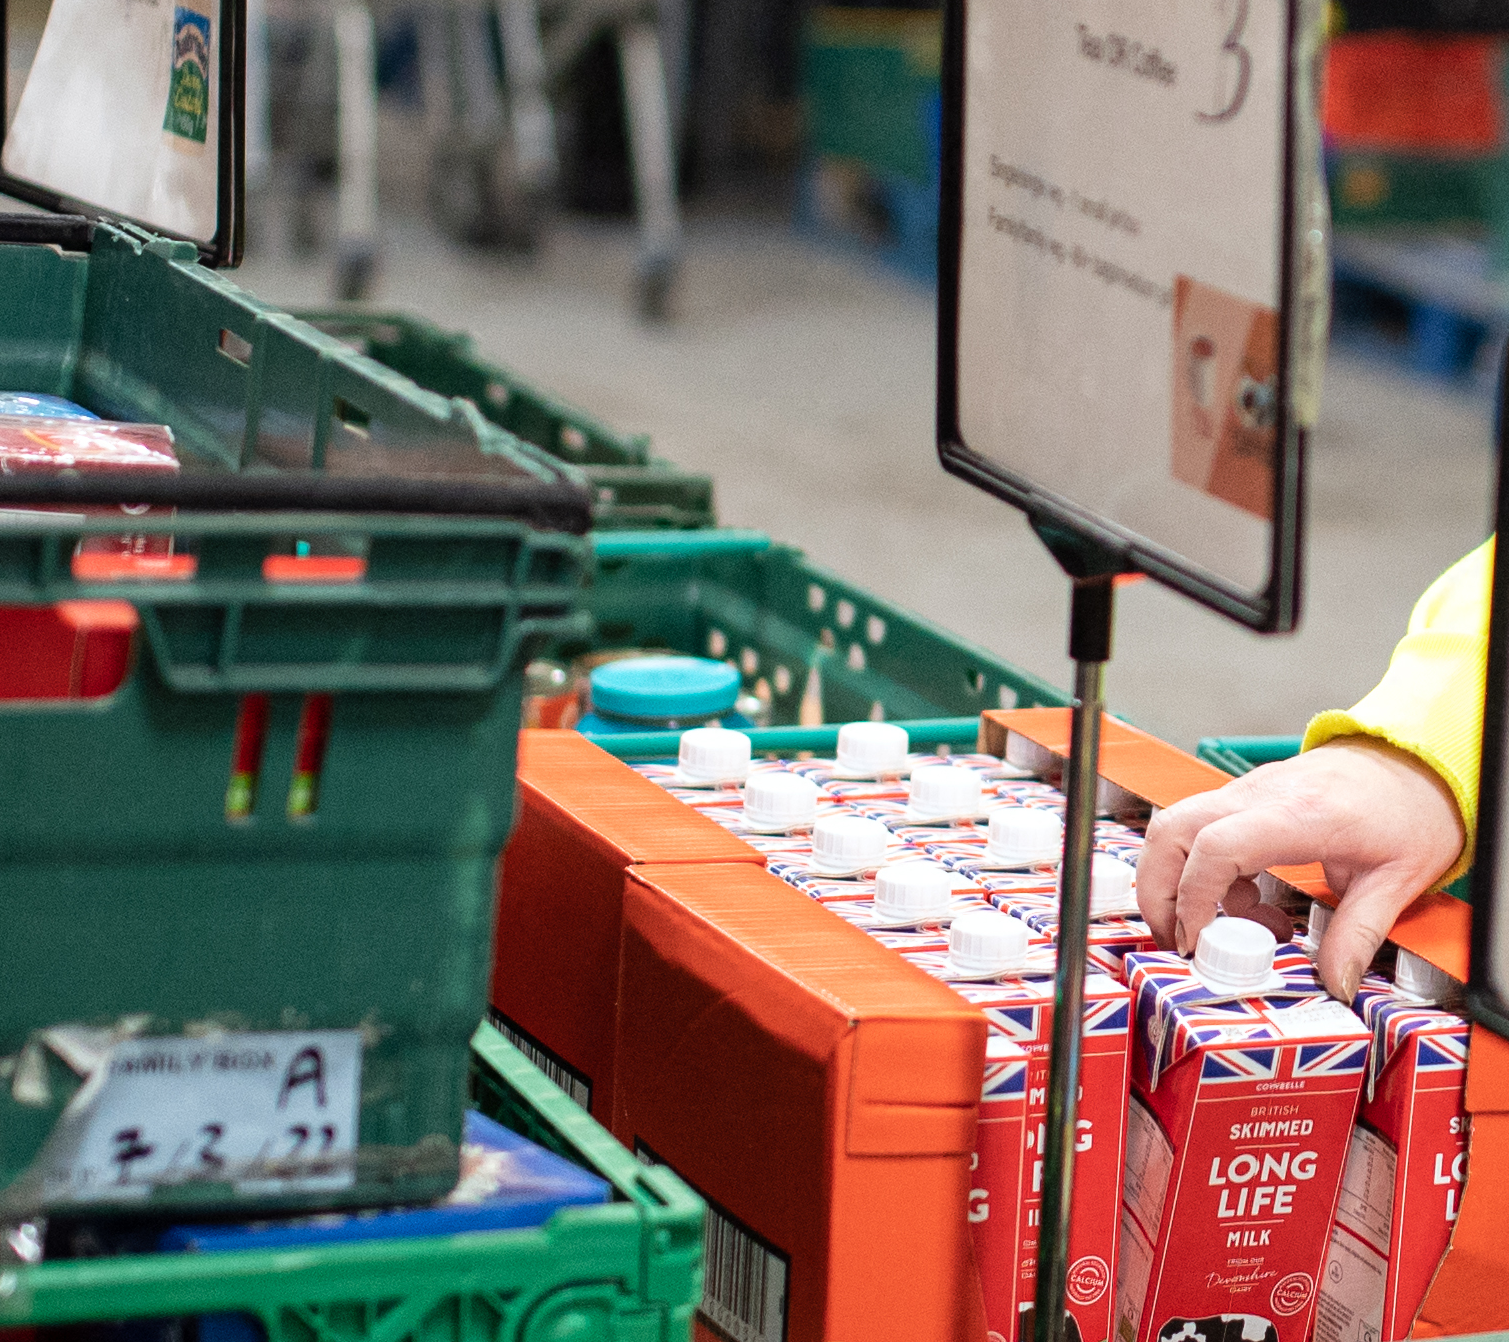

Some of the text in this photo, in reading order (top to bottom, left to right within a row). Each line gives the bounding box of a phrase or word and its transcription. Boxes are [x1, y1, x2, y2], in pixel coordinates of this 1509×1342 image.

[277, 1044, 329, 1110] A
[1250, 1105, 1300, 1118] BRITISH
[1228, 1119, 1314, 1141] SKIMMED
[1208, 1150, 1319, 1187] LONG
[1217, 1184, 1297, 1219] LIFE
[1226, 1229, 1272, 1248] MILK
[1070, 1273, 1104, 1287] CALCIUM
